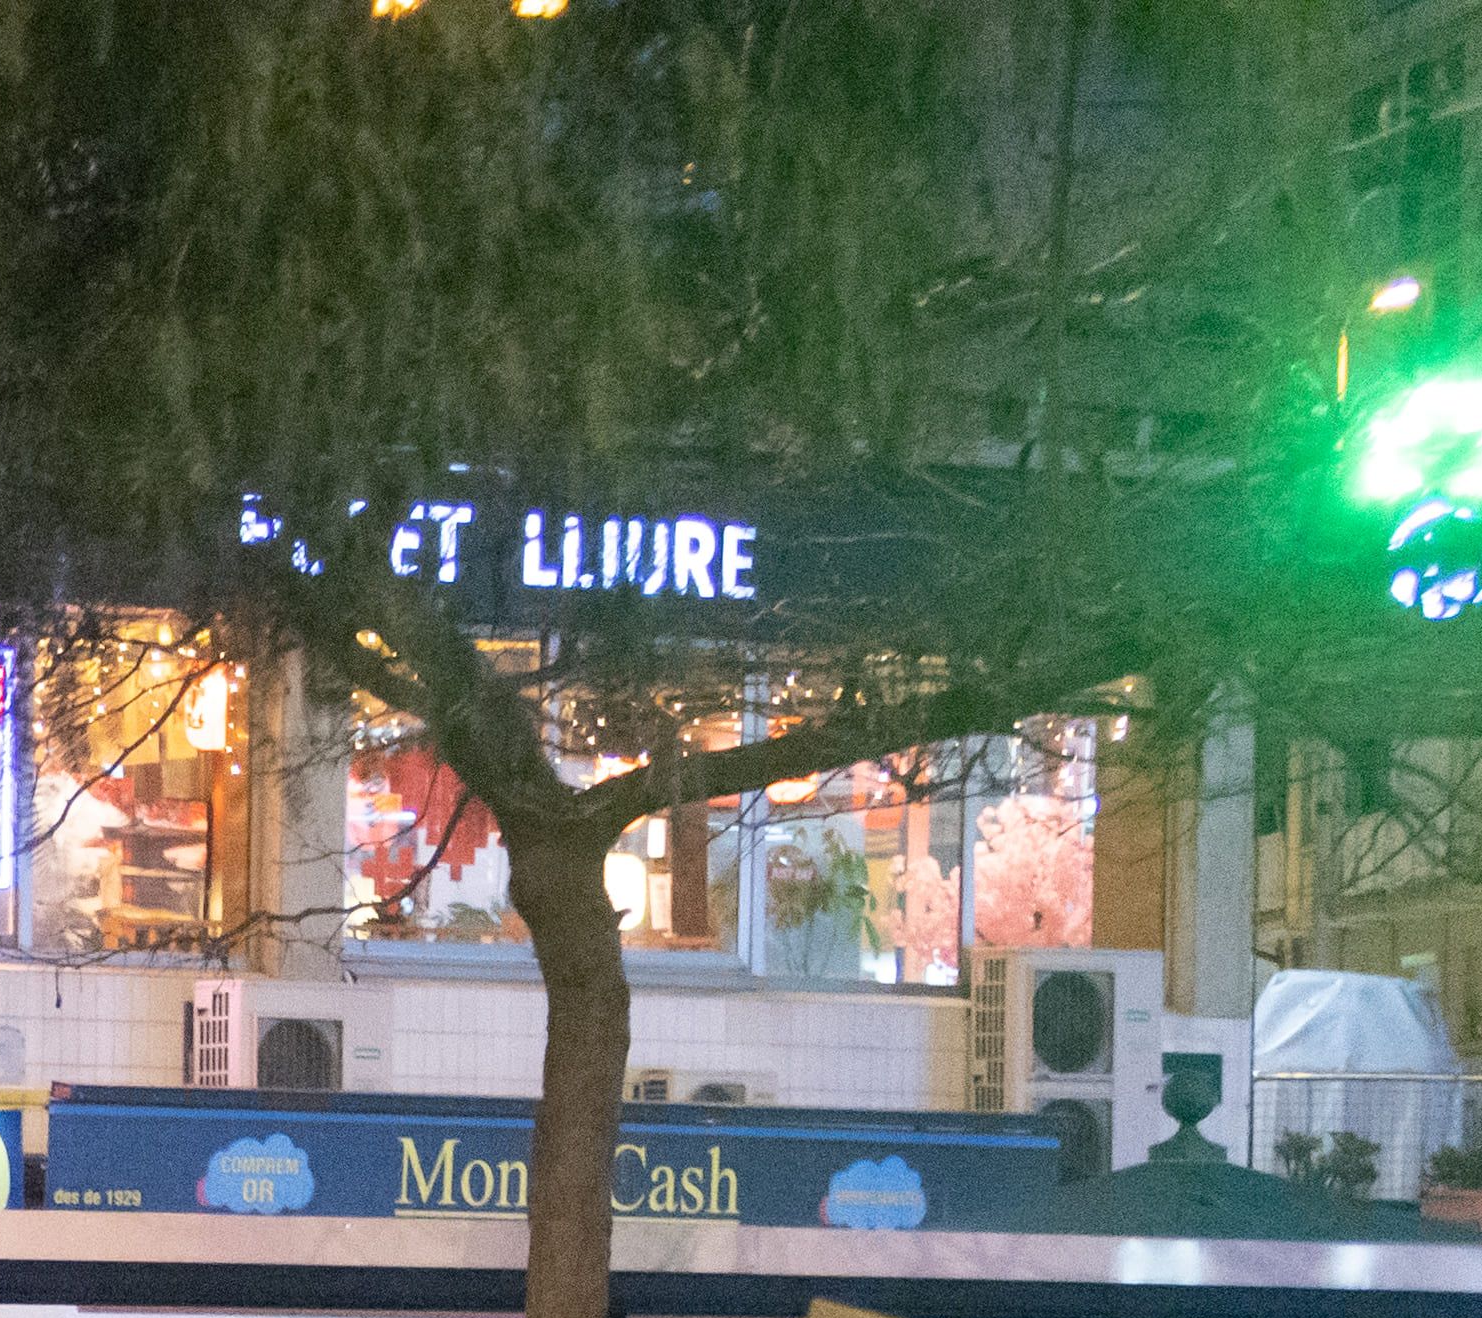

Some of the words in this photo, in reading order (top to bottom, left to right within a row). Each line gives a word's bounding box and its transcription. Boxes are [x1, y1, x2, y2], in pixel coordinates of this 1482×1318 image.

[220, 1156, 300, 1175] COMPREM
[395, 1136, 530, 1209] Mon
[611, 1143, 740, 1216] Cash
[83, 1188, 102, 1206] de
[106, 1189, 142, 1207] 1929
[242, 1179, 274, 1202] OR
